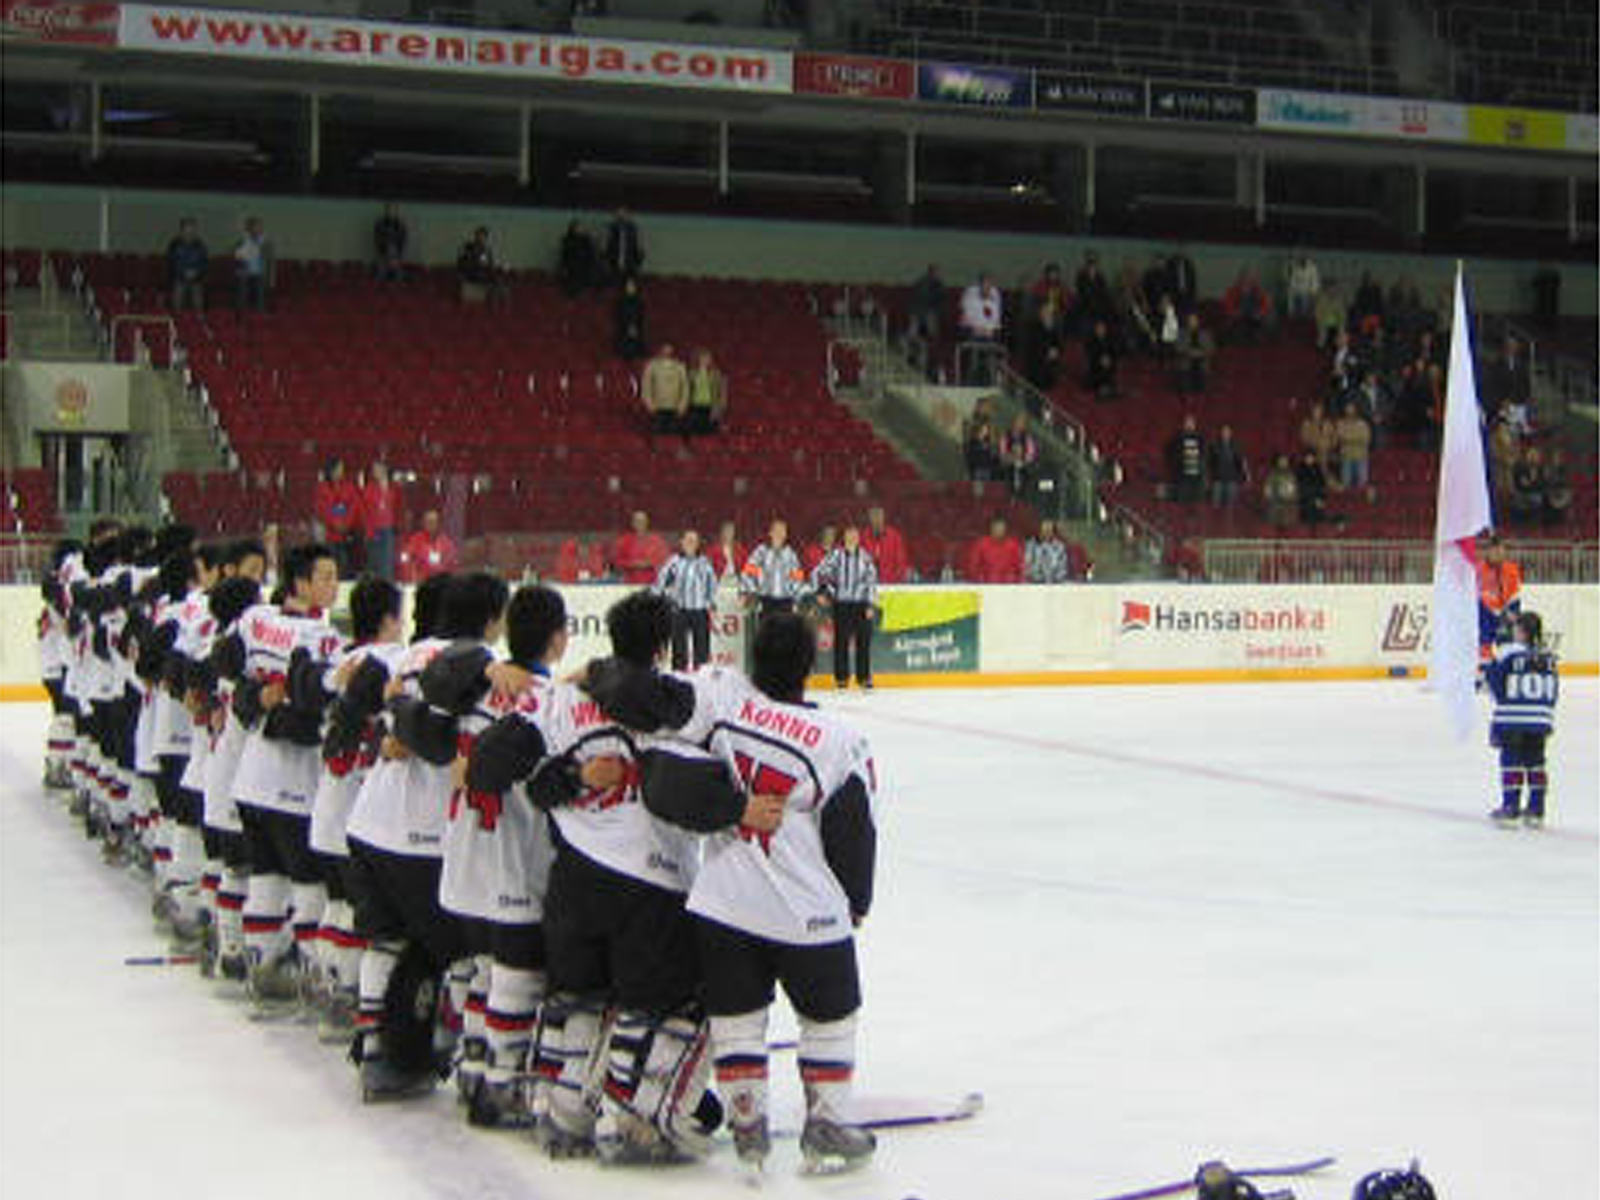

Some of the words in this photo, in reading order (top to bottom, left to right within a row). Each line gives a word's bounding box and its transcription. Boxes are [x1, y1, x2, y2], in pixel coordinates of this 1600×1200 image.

[151, 14, 767, 79] www.arenariga.com
[1156, 603, 1326, 633] Hansabanka
[739, 699, 824, 749] KONNO
